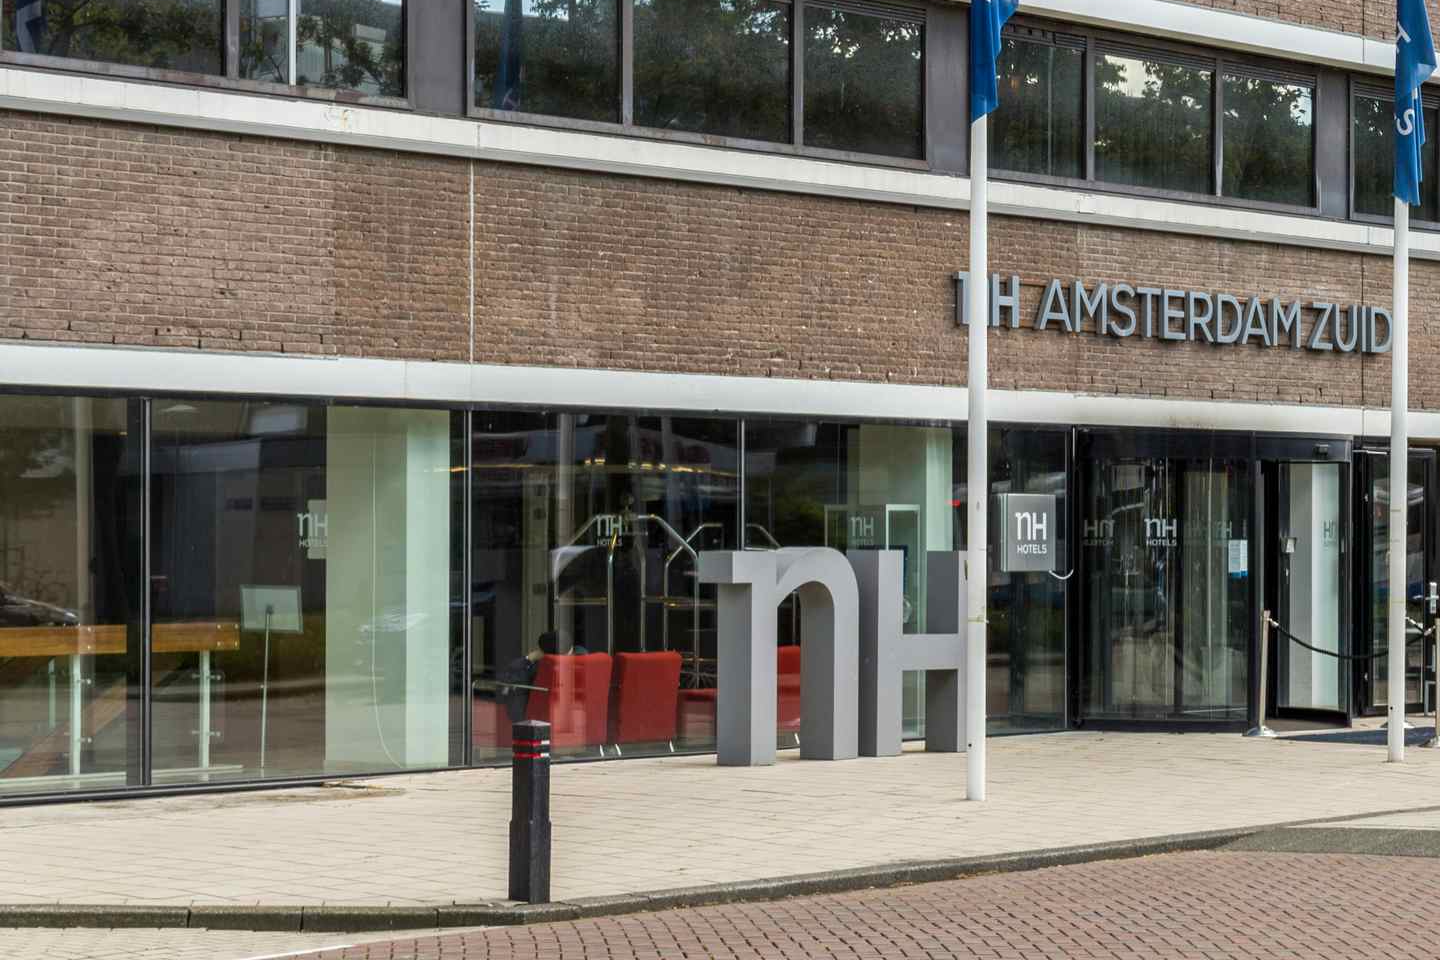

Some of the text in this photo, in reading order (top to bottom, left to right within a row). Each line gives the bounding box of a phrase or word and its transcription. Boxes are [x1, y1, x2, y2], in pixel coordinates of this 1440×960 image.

[1036, 278, 1301, 350] AMSTERDAM
[1307, 302, 1394, 353] ZUID
[1016, 543, 1047, 555] HOTELS
